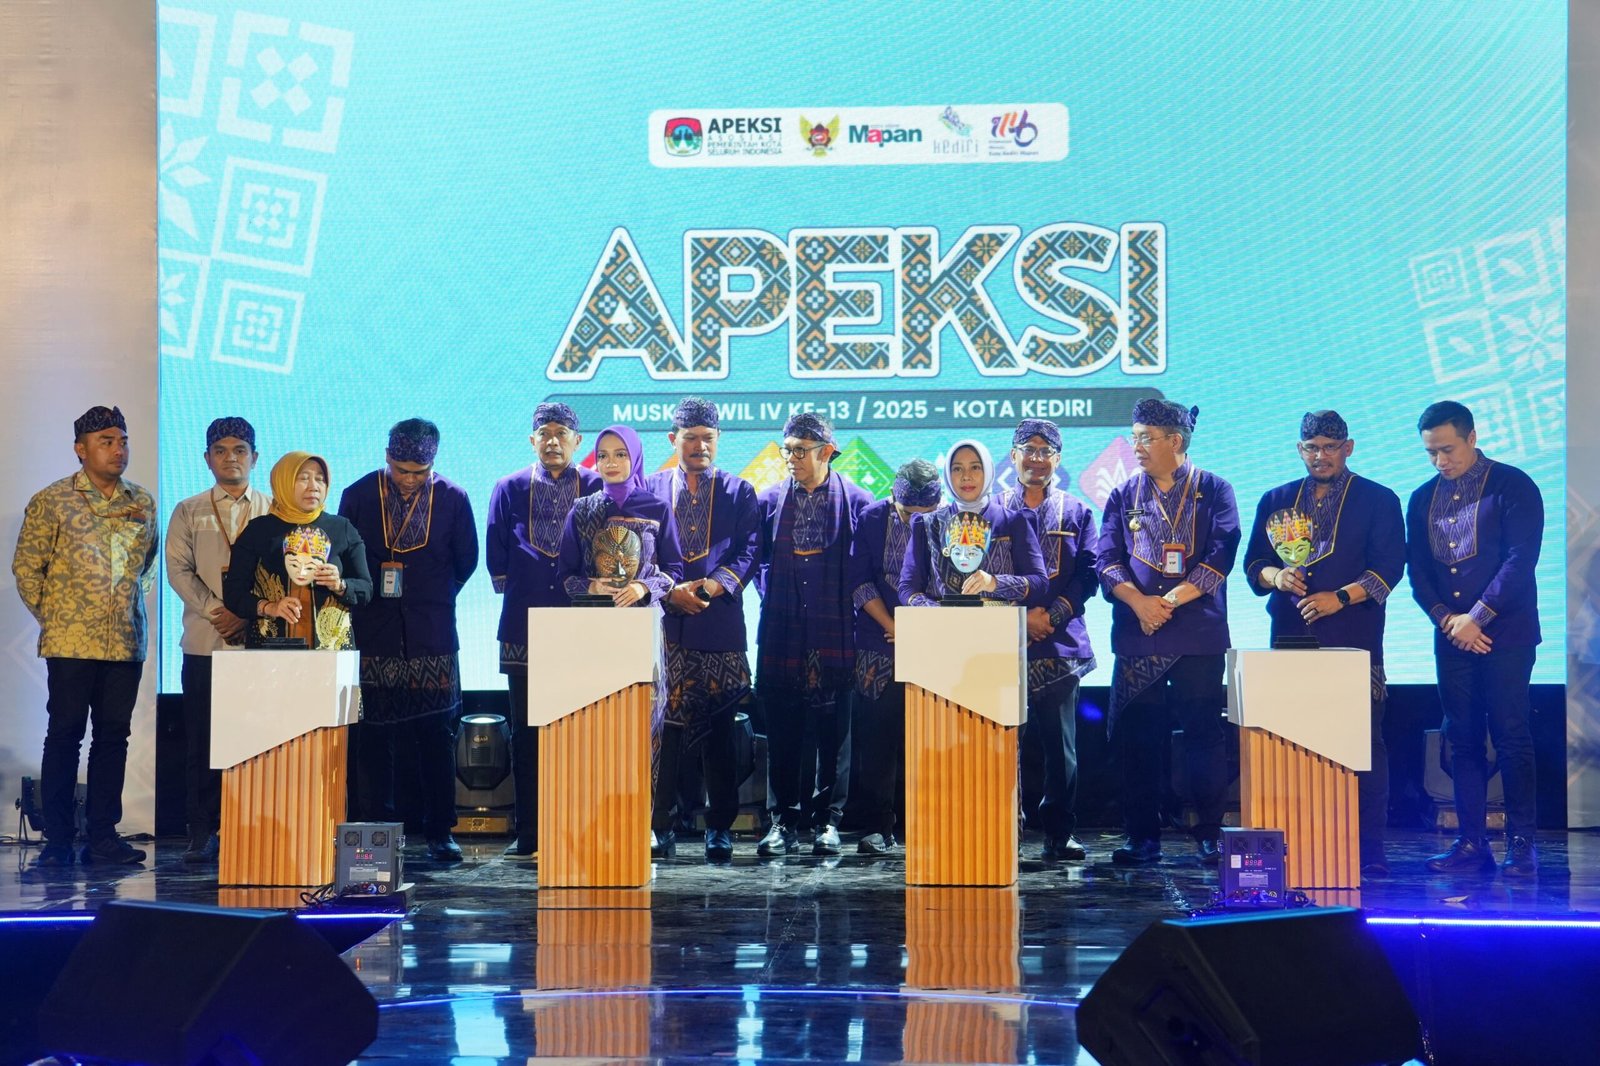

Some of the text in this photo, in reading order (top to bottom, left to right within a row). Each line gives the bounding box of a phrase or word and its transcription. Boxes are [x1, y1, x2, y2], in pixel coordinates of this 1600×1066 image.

[707, 117, 782, 133] APEKSI
[848, 125, 923, 147] Mapan
[546, 222, 1167, 380] APEKSI
[613, 402, 754, 421] MUSKWIL
[760, 402, 783, 420] IV
[788, 400, 850, 420] KE-13
[855, 396, 867, 423] /
[873, 400, 928, 419] 2025
[953, 400, 1015, 418] KOTA
[1021, 399, 1092, 417] KEDIRI
